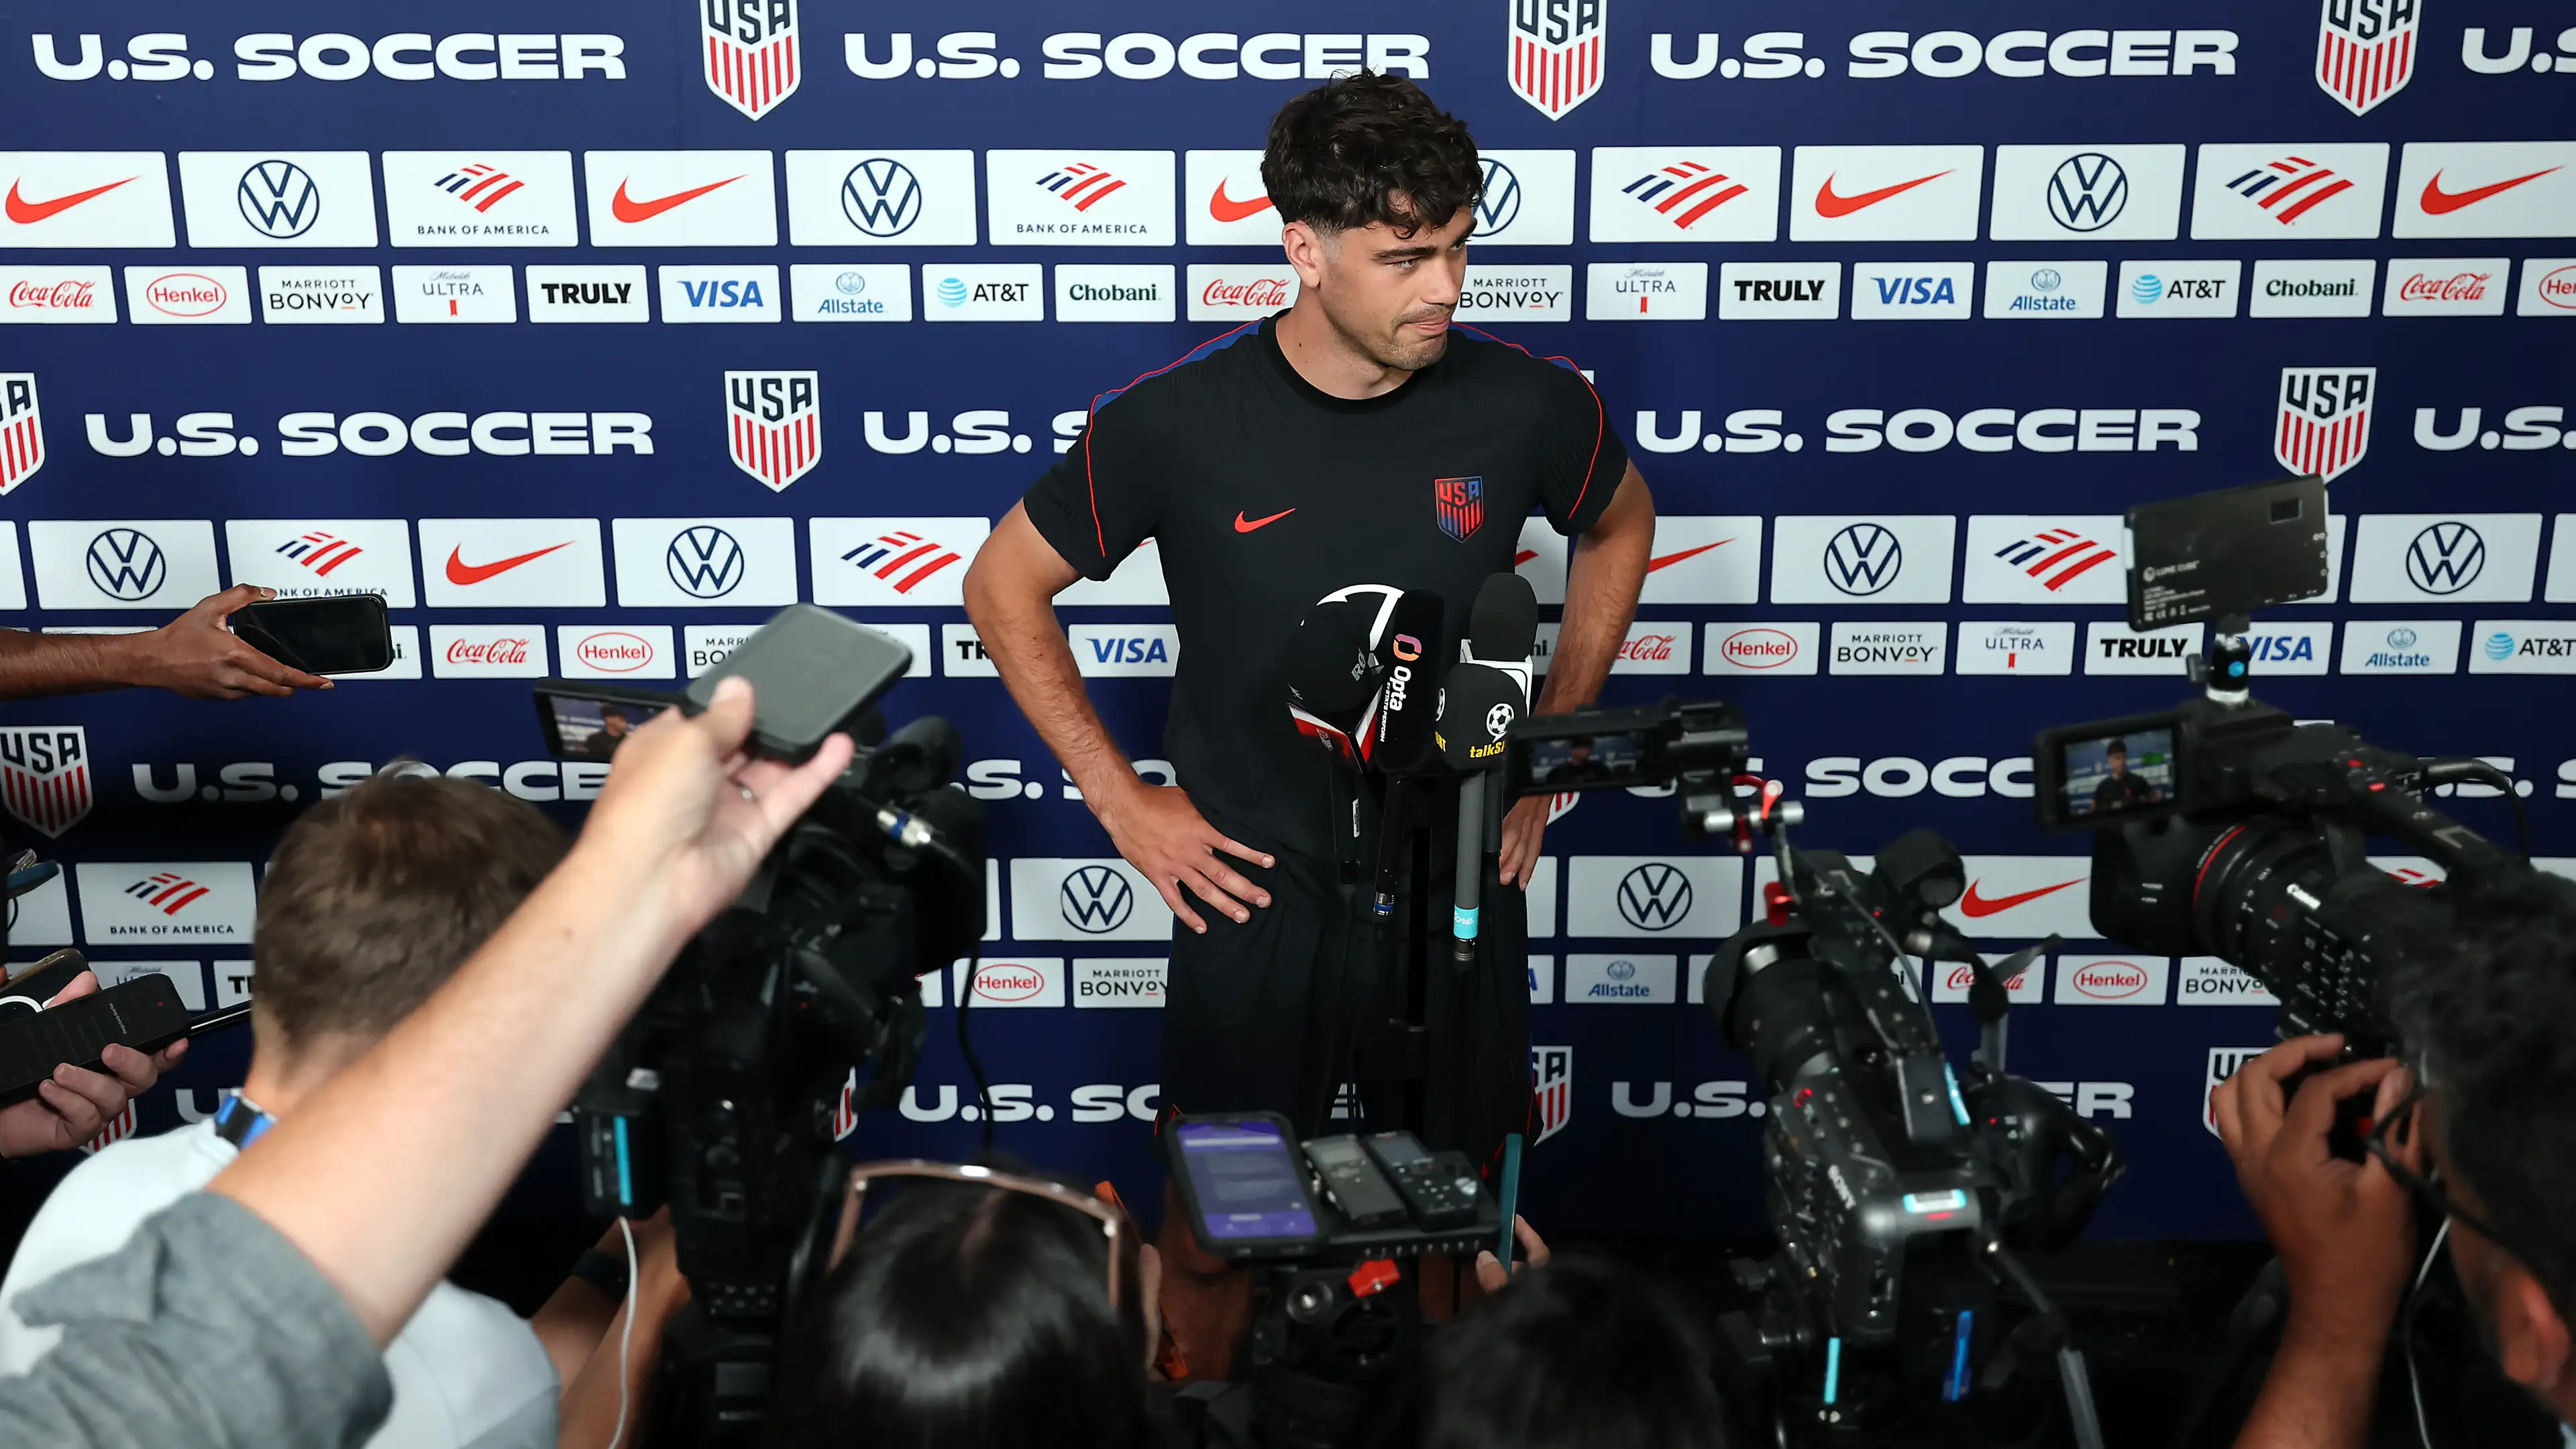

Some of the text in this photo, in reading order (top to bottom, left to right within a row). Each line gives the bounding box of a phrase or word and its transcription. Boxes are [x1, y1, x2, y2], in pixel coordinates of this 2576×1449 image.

[32, 33, 627, 81] U.S. SOCCER
[844, 32, 1430, 79] U.S. SOCCER
[1650, 30, 2239, 80] U.S. SOCCER
[417, 225, 549, 235] BANK OF AMERICA
[1016, 223, 1147, 234] BANK OF AMERICA
[282, 280, 358, 289] MARRIOTT
[422, 283, 483, 296] ULTRA
[973, 283, 1029, 302] AT&T
[1069, 283, 1157, 301] Chobani
[1473, 278, 1547, 288] MARRIOTT
[1615, 280, 1676, 293] ULTRA
[1734, 280, 1825, 301] TRULY
[1871, 277, 1955, 305] VISA
[2167, 280, 2226, 299] AT&T
[2265, 278, 2355, 297] Chobani
[2400, 273, 2489, 301] Coca-Cola
[9, 280, 95, 308] Coca-Cola
[154, 286, 220, 304] Henkel
[270, 292, 370, 309] BONVOY
[541, 283, 631, 305] TRULY
[678, 280, 764, 307] VISA
[1203, 280, 1291, 307] Coca-Cola
[1460, 291, 1564, 310] BONVOY
[817, 299, 883, 314] Allstate
[2009, 296, 2076, 311] Allstate
[731, 377, 813, 423] USA
[2285, 374, 2369, 419] USA
[85, 411, 654, 457] U.S. SOCCER
[863, 410, 1032, 454] U.S.
[1635, 408, 2201, 453] U.S. SOCCER
[2414, 406, 2576, 451] U.S.
[1439, 480, 1480, 506] USA
[303, 588, 319, 596] OF
[1728, 637, 1791, 657] Henkel
[1851, 634, 1922, 643] MARRIOTT
[1985, 637, 2044, 649] ULTRA
[2100, 639, 2188, 657] TRULY
[2518, 639, 2575, 656] AT&T
[446, 639, 527, 663] Coca-Cola
[584, 641, 647, 661] Henkel
[1087, 638, 1168, 663] VISA
[1837, 646, 1934, 662] BONVOY
[2365, 653, 2430, 667] Allstate
[1389, 664, 1411, 712] Opta
[1379, 714, 1387, 743] PERFORM
[1, 733, 80, 773] USA
[131, 761, 299, 800] U.S.
[1805, 757, 2035, 798] SOCC
[110, 925, 234, 934] BANK OF AMERICA
[978, 976, 1037, 989] Henkel
[1092, 969, 1160, 978] MARRIOTT
[2081, 973, 2140, 987] Henkel
[1588, 983, 1650, 997] Allstate
[2186, 978, 2264, 995] BONVO
[900, 1084, 1055, 1122] U.S.
[1612, 1080, 1766, 1118] U.S.
